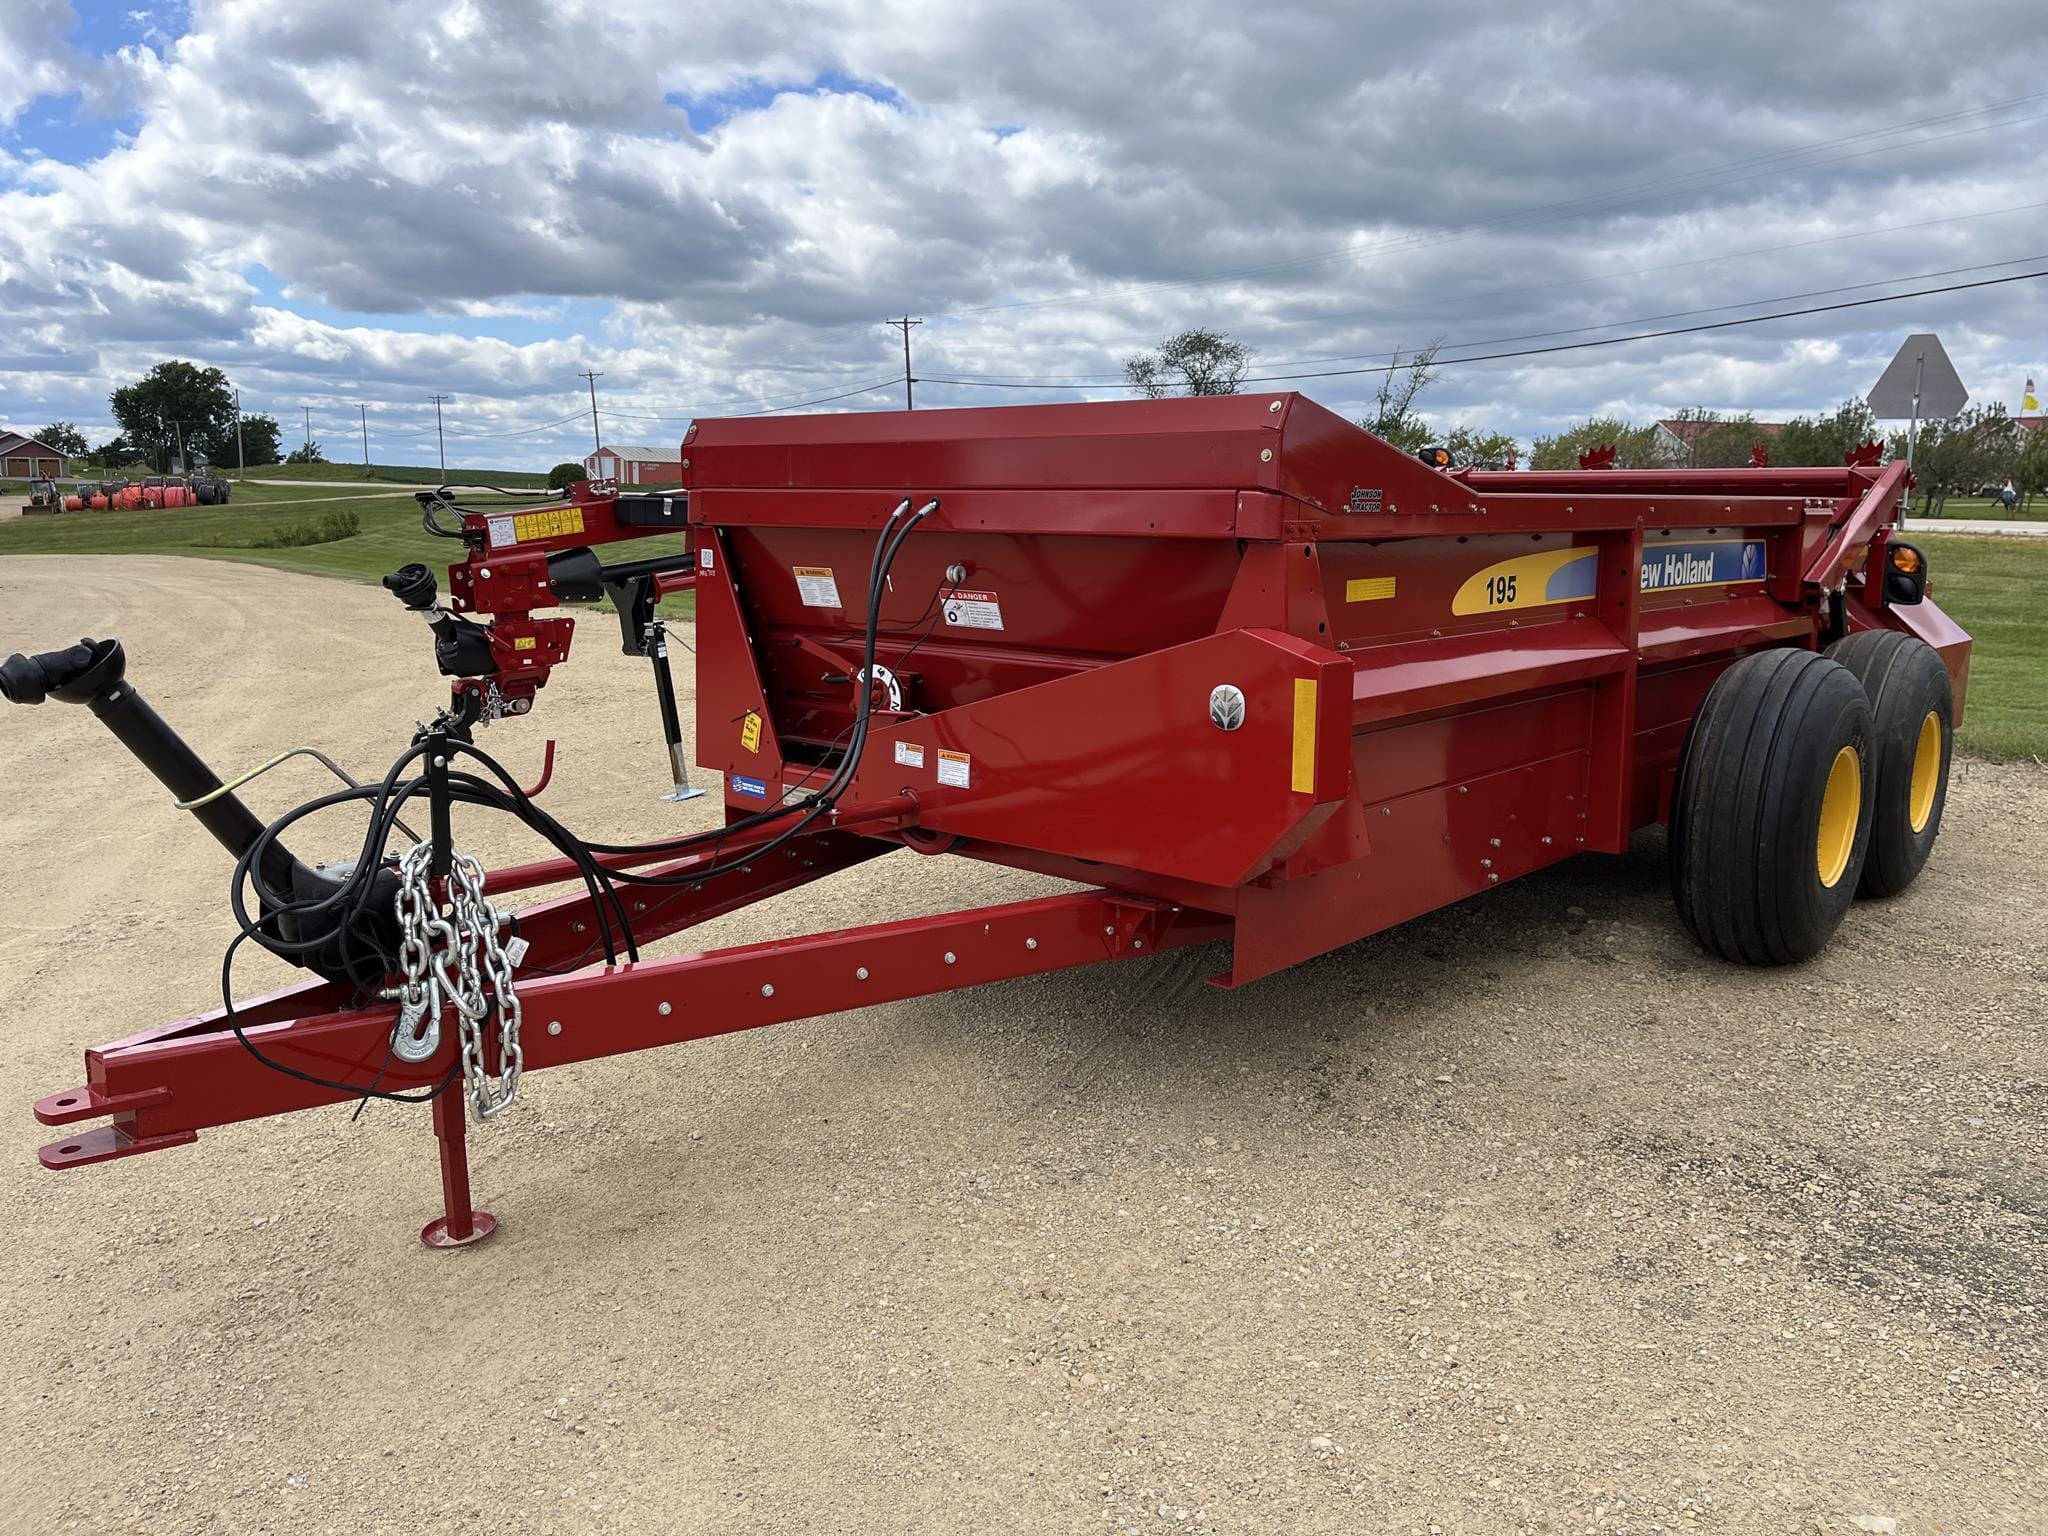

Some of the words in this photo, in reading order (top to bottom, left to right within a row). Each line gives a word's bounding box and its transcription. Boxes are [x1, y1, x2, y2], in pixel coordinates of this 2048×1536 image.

[1351, 485, 1382, 500] JOHNSON
[1351, 499, 1381, 513] TRACTOR
[1640, 563, 1662, 588] ew
[1664, 551, 1715, 586] Holland
[957, 592, 988, 600] DANGER
[1486, 575, 1517, 605] 195
